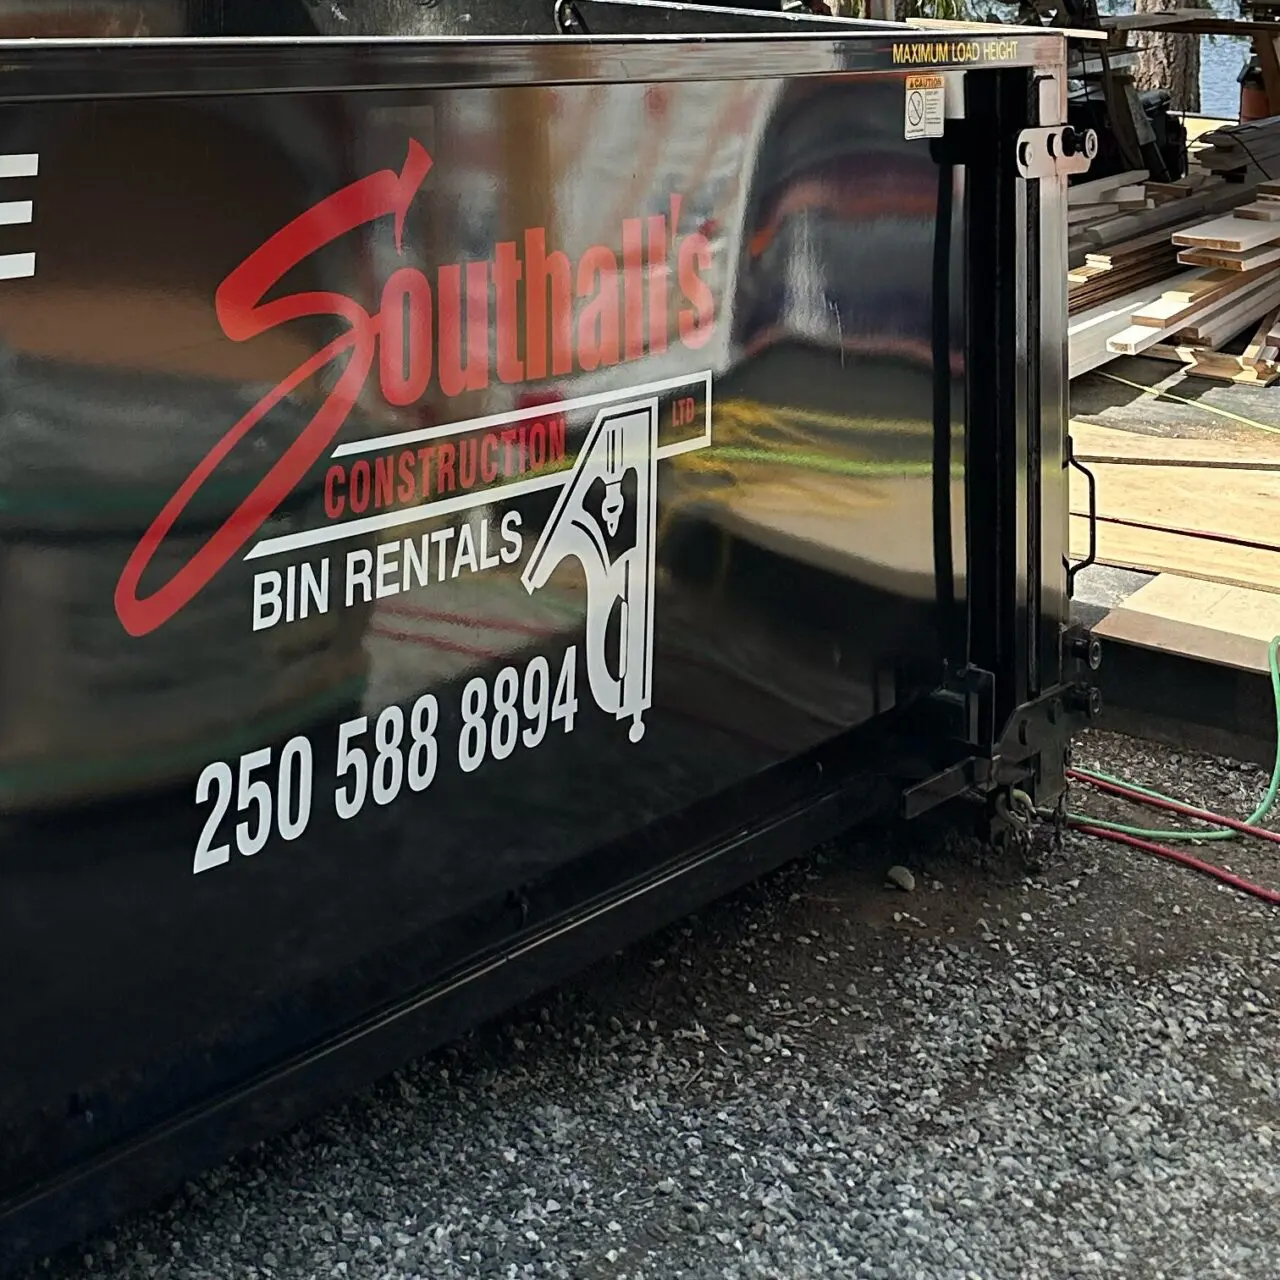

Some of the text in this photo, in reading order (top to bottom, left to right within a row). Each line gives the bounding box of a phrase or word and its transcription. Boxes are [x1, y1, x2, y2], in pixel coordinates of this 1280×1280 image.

[892, 40, 1018, 64] MAXIMUM LOAD HEIGHT
[914, 77, 942, 88] CAUTION
[114, 137, 717, 637] Southall's
[323, 396, 696, 519] CONSTRUCTION LTD
[252, 508, 523, 632] BIN RENTALS
[193, 644, 579, 874] 250 588 8894
